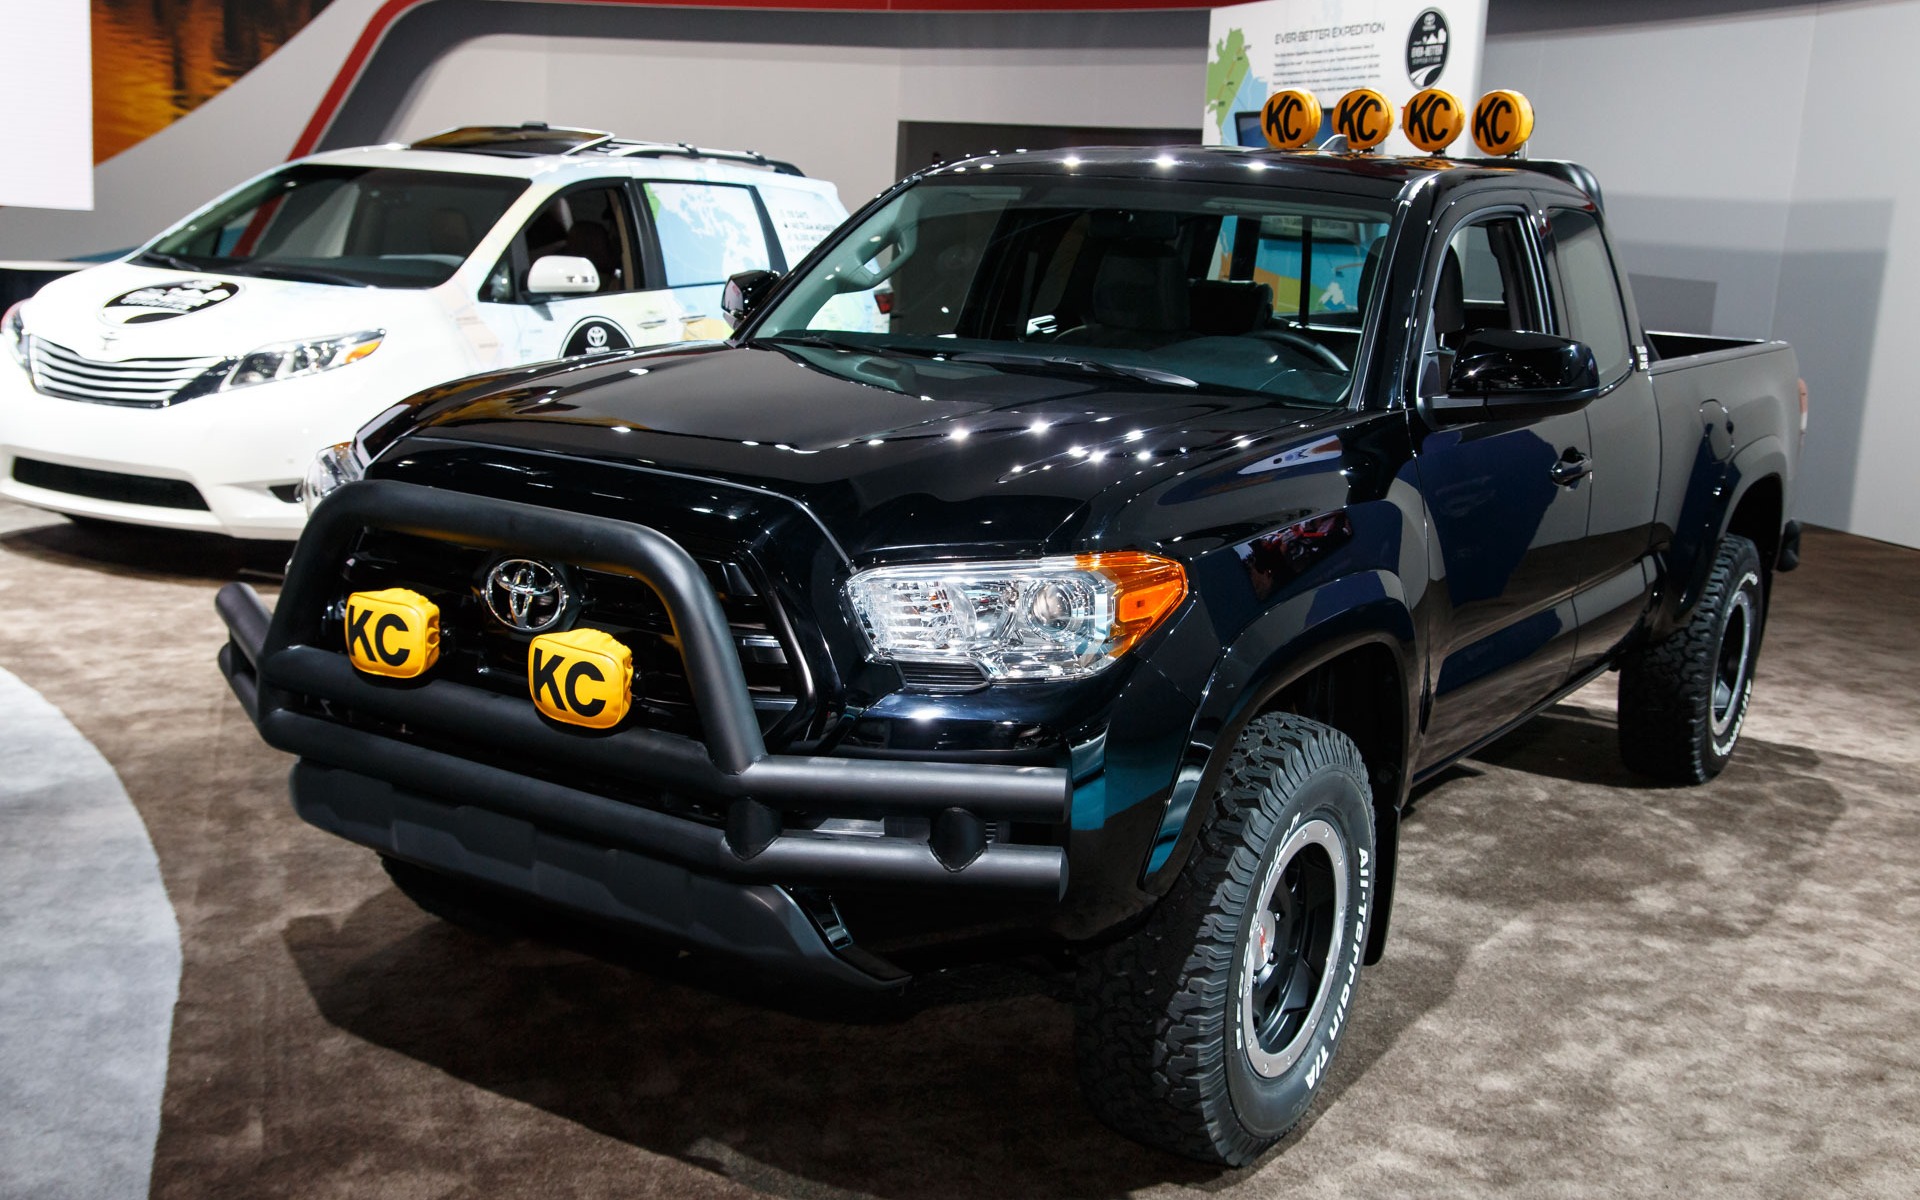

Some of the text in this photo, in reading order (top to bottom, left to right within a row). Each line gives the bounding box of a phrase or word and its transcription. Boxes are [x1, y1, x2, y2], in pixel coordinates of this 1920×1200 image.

[1332, 21, 1386, 39] EXPEDITION
[1266, 95, 1303, 143] KC
[1338, 94, 1382, 143] KC
[1407, 94, 1452, 144] KC
[1474, 97, 1513, 148] KC
[349, 604, 411, 667] KC
[533, 647, 607, 718] KC
[1328, 847, 1369, 1042] All-Terrain
